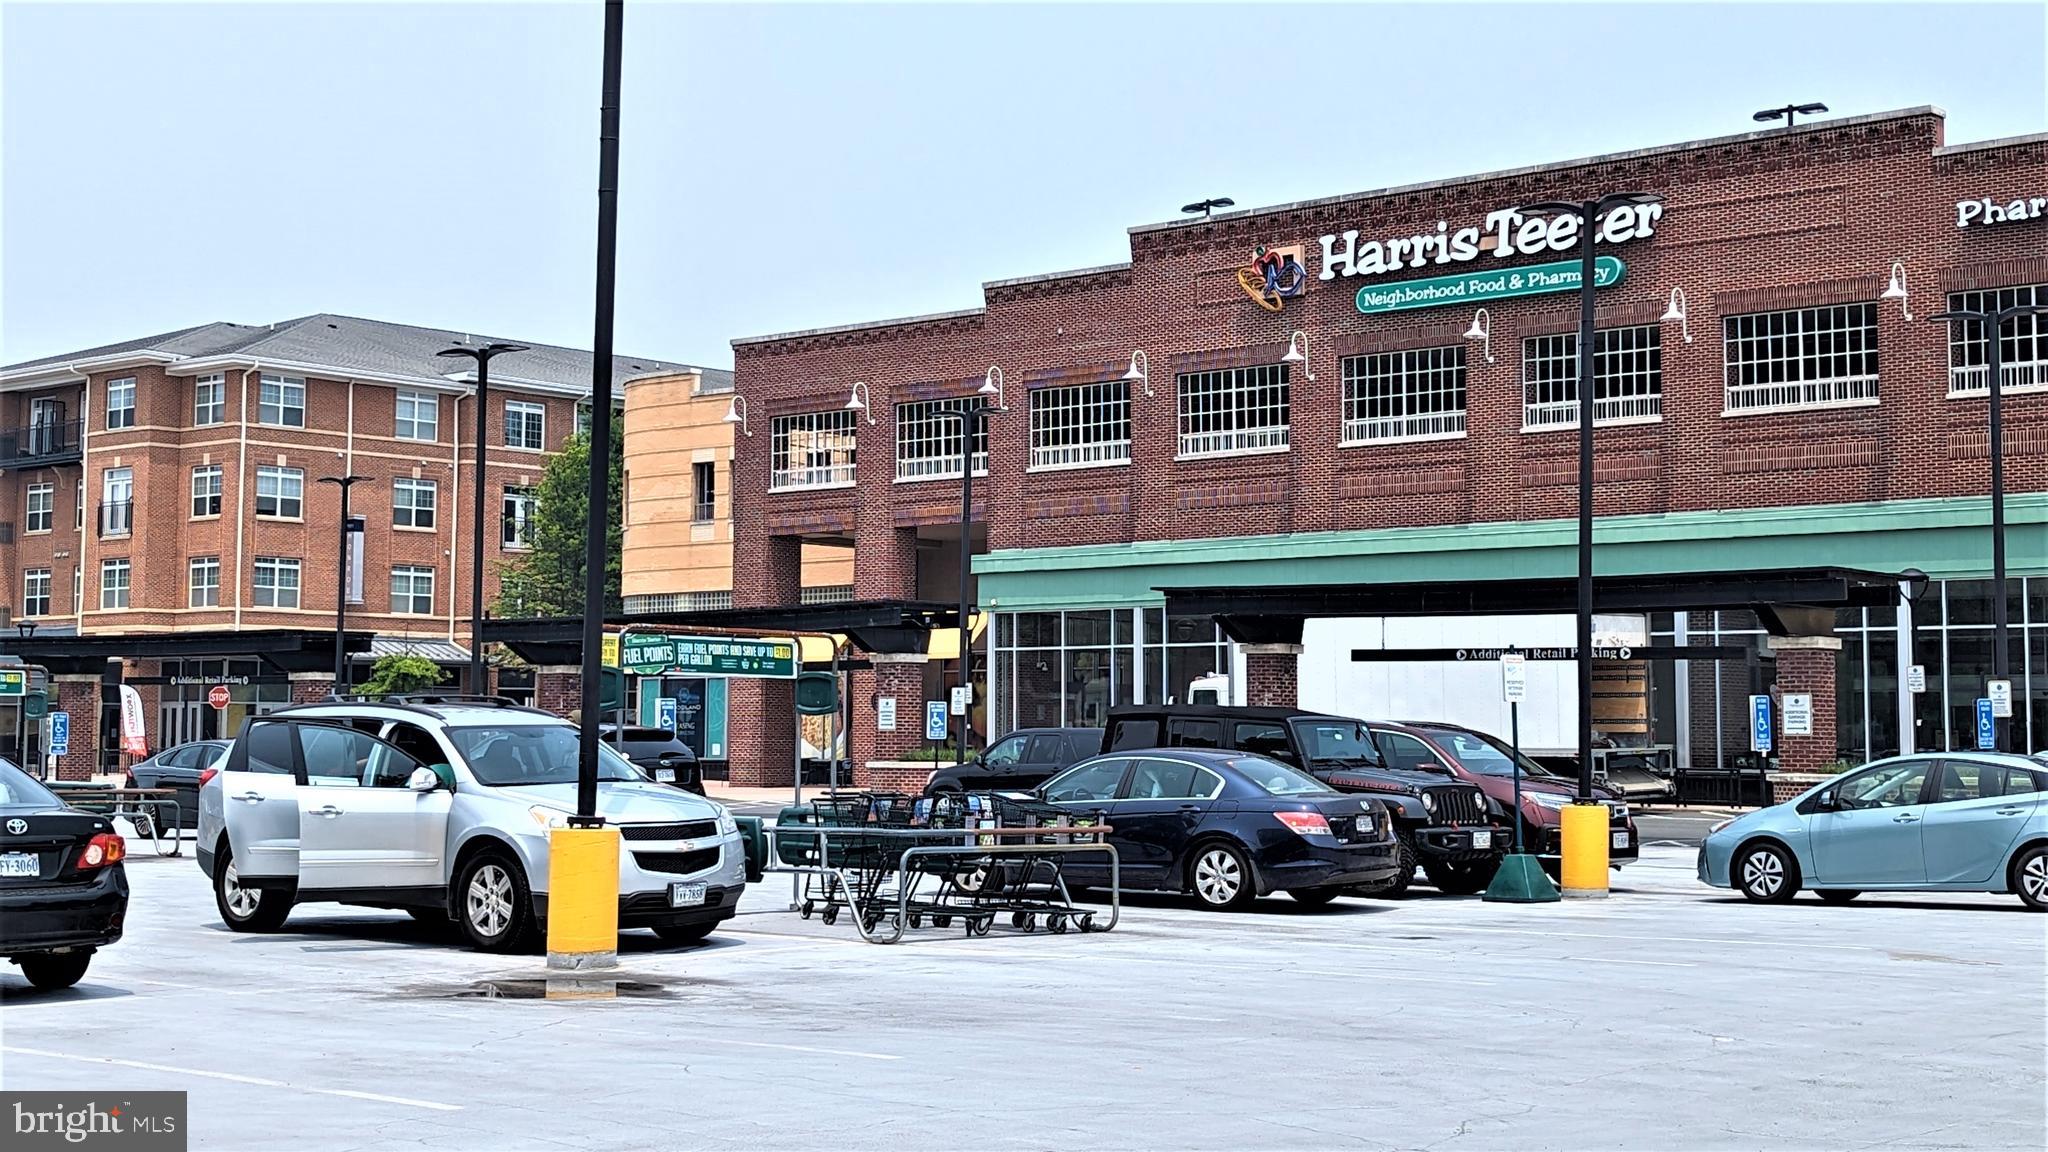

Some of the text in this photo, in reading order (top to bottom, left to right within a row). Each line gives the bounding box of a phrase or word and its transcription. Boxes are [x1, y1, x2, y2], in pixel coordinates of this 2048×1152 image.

[1956, 197, 2048, 227] Phar
[1318, 202, 1663, 281] Harris Teeer
[1364, 265, 1610, 308] Neighborhood Food & Pharmcy
[623, 648, 644, 665] FUEL
[644, 646, 673, 663] POINTS
[678, 642, 693, 653] EARN
[694, 643, 707, 654] FUEL
[708, 643, 729, 655] POINTS
[730, 644, 742, 655] AND
[743, 645, 756, 656] SAVE
[757, 646, 766, 657] UP
[766, 647, 774, 657] TO
[1469, 648, 1529, 660] Additial
[1533, 647, 1566, 659] Retail
[1569, 647, 1617, 661] Pking
[678, 654, 689, 665] PER
[690, 654, 713, 665] GALLON
[177, 676, 242, 685] Additional Retail Parking
[210, 693, 228, 701] STOP
